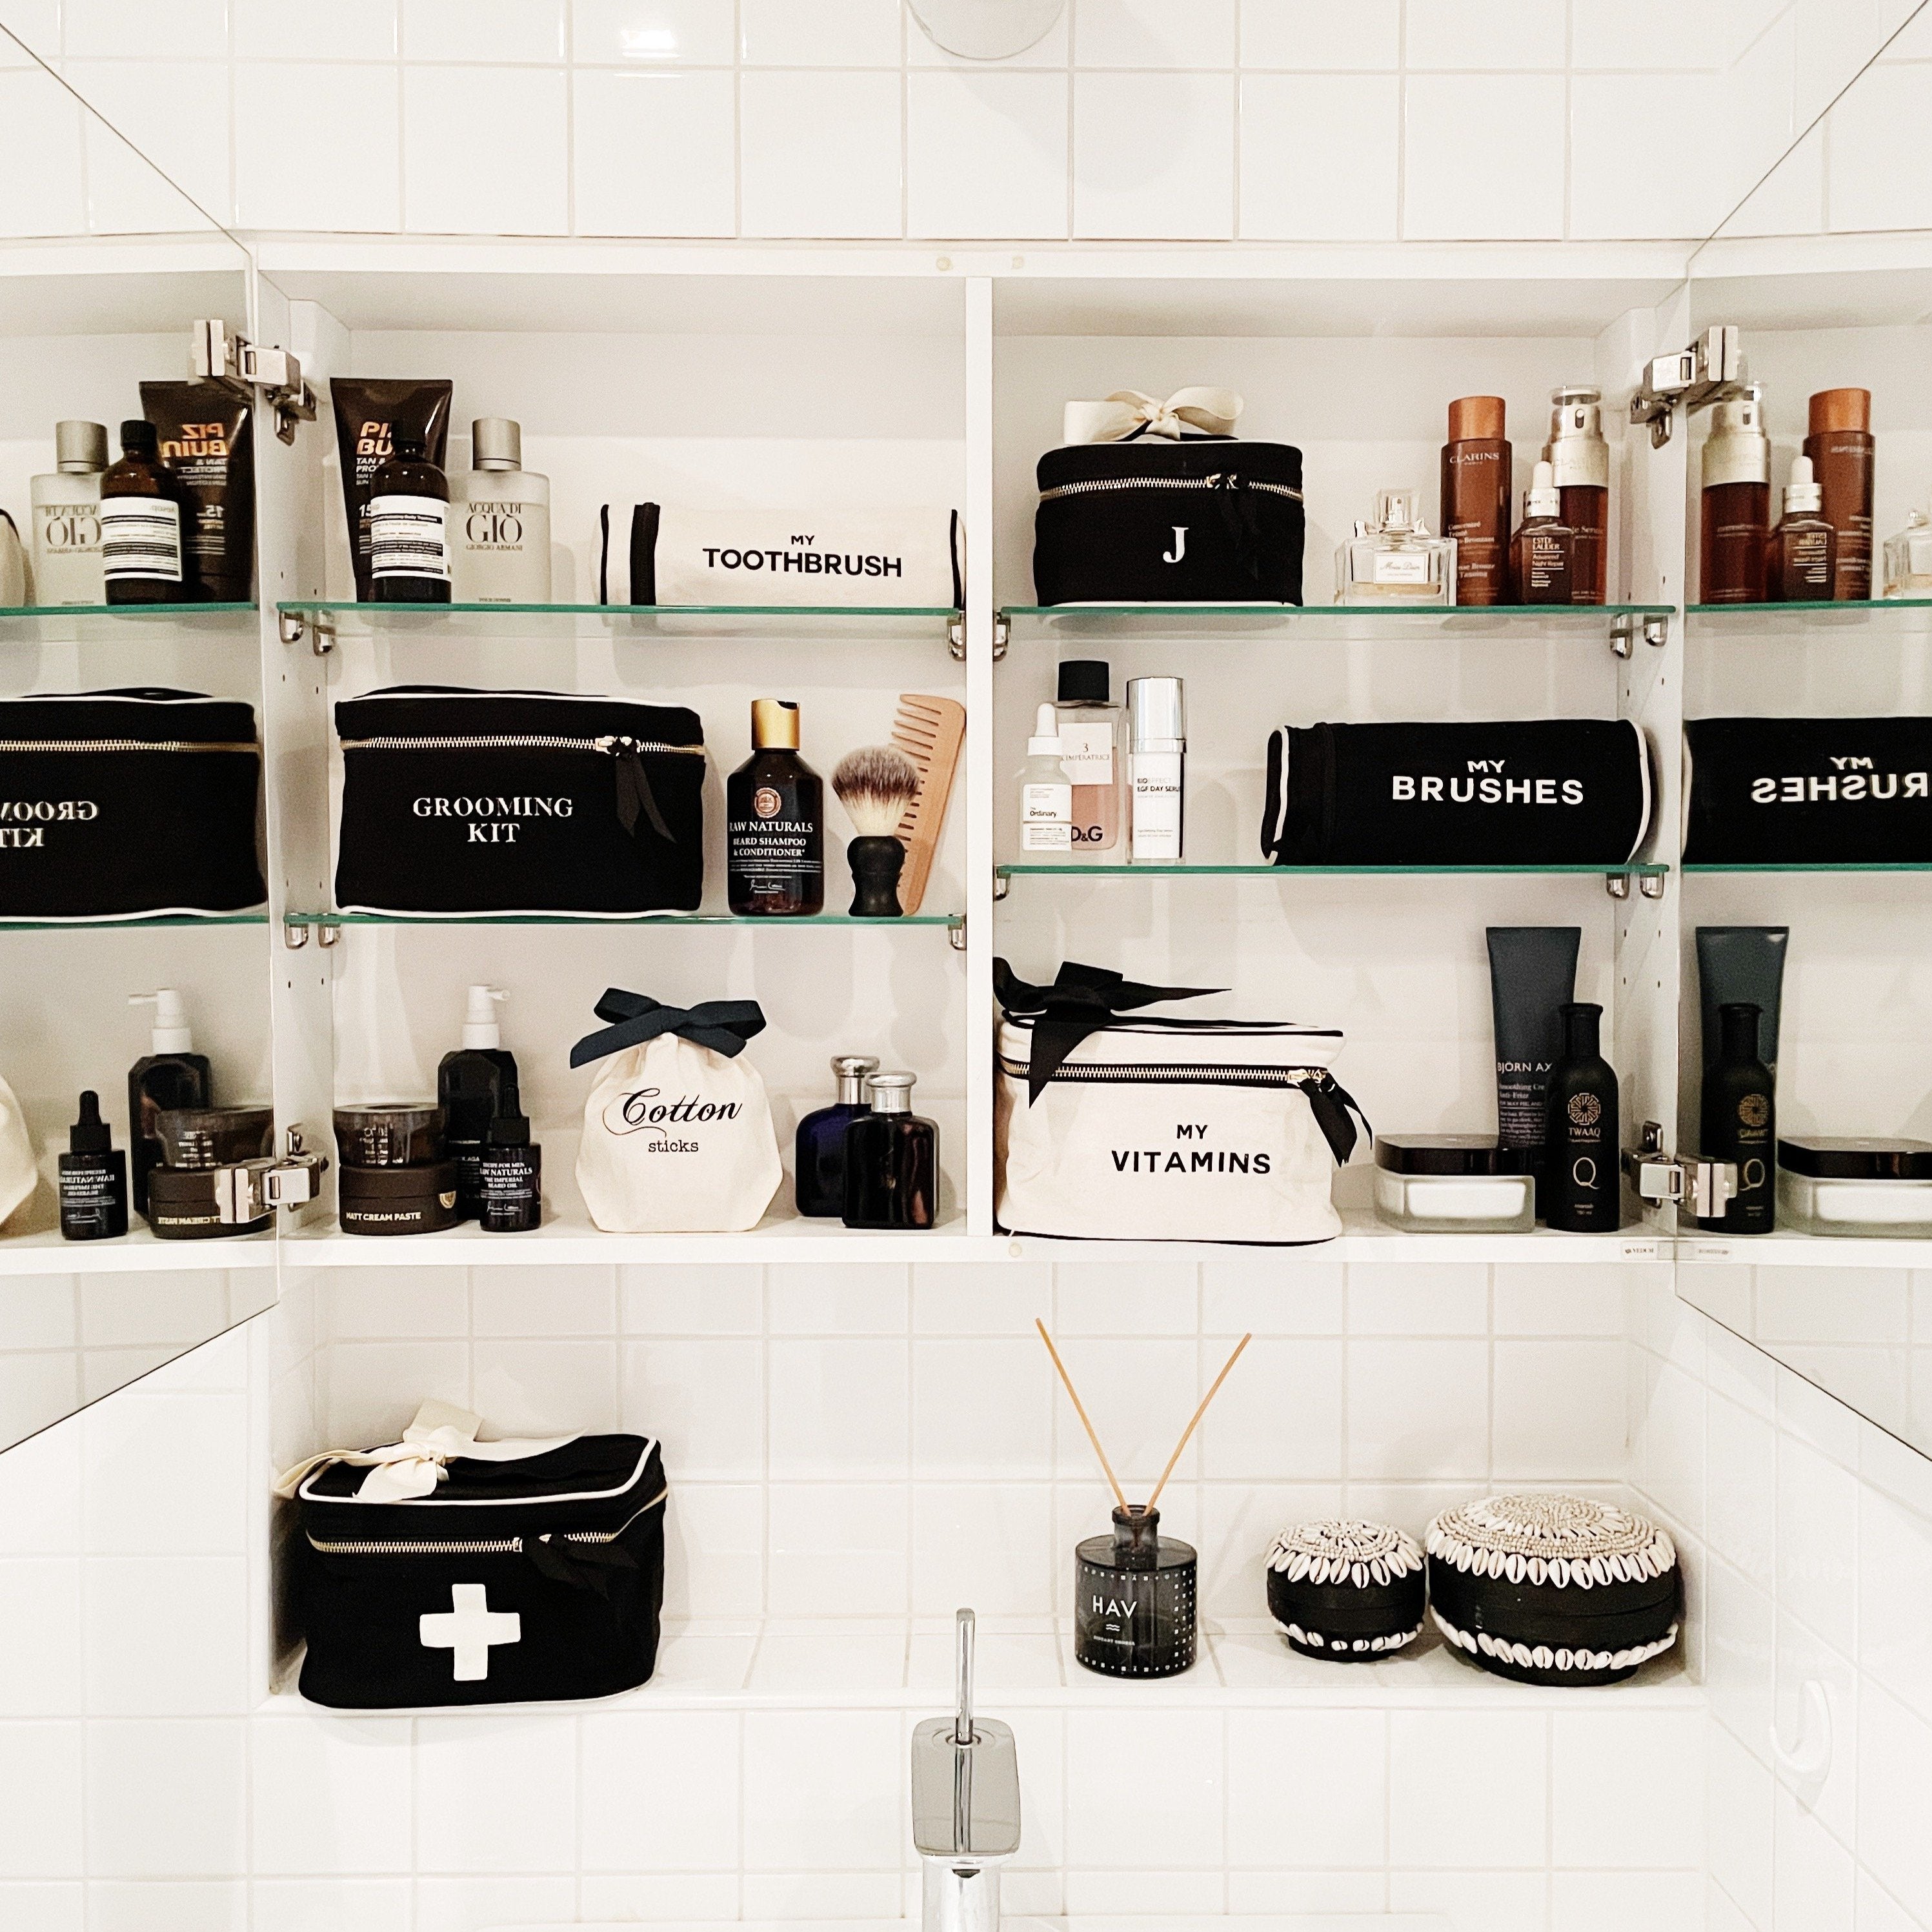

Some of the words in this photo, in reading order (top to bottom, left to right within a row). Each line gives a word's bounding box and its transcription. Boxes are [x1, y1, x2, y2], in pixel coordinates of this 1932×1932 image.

[361, 421, 392, 438] PI
[357, 439, 394, 456] BU
[467, 503, 506, 514] ACQUA
[510, 503, 521, 514] DI
[790, 535, 815, 546] MY
[1162, 526, 1189, 563] J
[702, 548, 901, 578] TOOTHBRUSH
[1083, 743, 1089, 752] 3
[1467, 760, 1505, 773] MY
[1393, 776, 1584, 805] BRUSHES
[413, 797, 573, 817] GROOMING
[467, 823, 520, 842] KIT
[749, 821, 813, 832] NATURALS
[1071, 826, 1103, 842] D&G
[759, 838, 806, 846] SHAMPOO
[1535, 1062, 1552, 1072] AX
[603, 1088, 743, 1138] Cotton
[1176, 1125, 1208, 1139] MY
[1568, 1127, 1601, 1138] TWAAQ
[648, 1140, 699, 1152] sticks
[1111, 1150, 1271, 1174] VITAMINS
[490, 1167, 533, 1176] NATURALS
[1573, 1157, 1600, 1189] Q
[394, 1212, 421, 1220] PASTE
[1092, 1595, 1137, 1618] HAV
